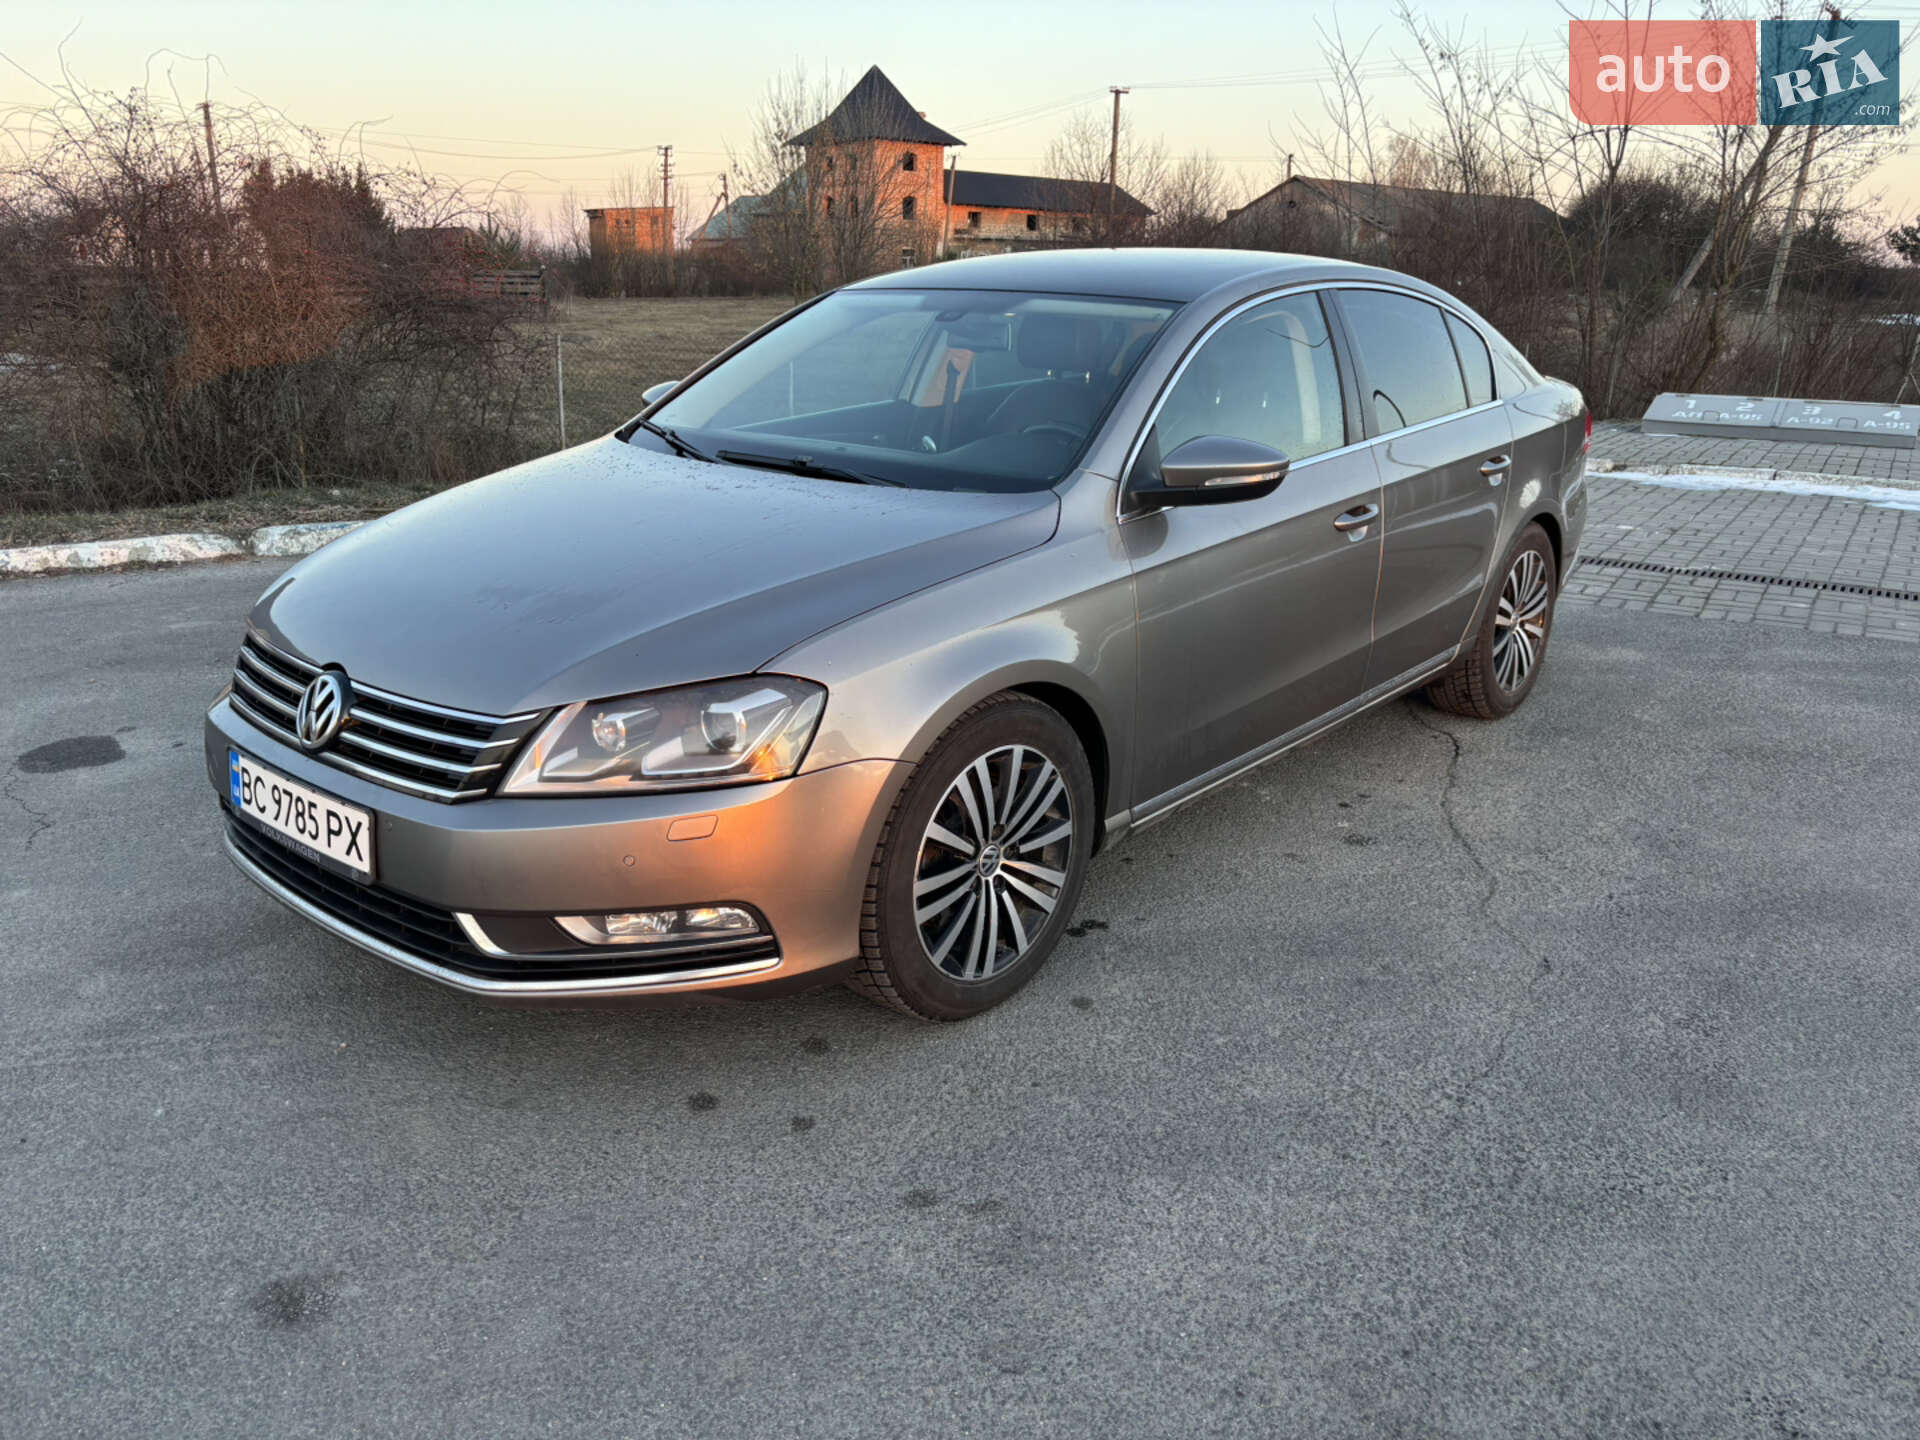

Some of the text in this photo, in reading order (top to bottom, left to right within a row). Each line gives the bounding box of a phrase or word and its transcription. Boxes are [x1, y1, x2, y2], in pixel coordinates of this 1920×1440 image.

[1685, 399, 1902, 421] 1 2 3 4
[240, 766, 364, 862] BC 9785 PX
